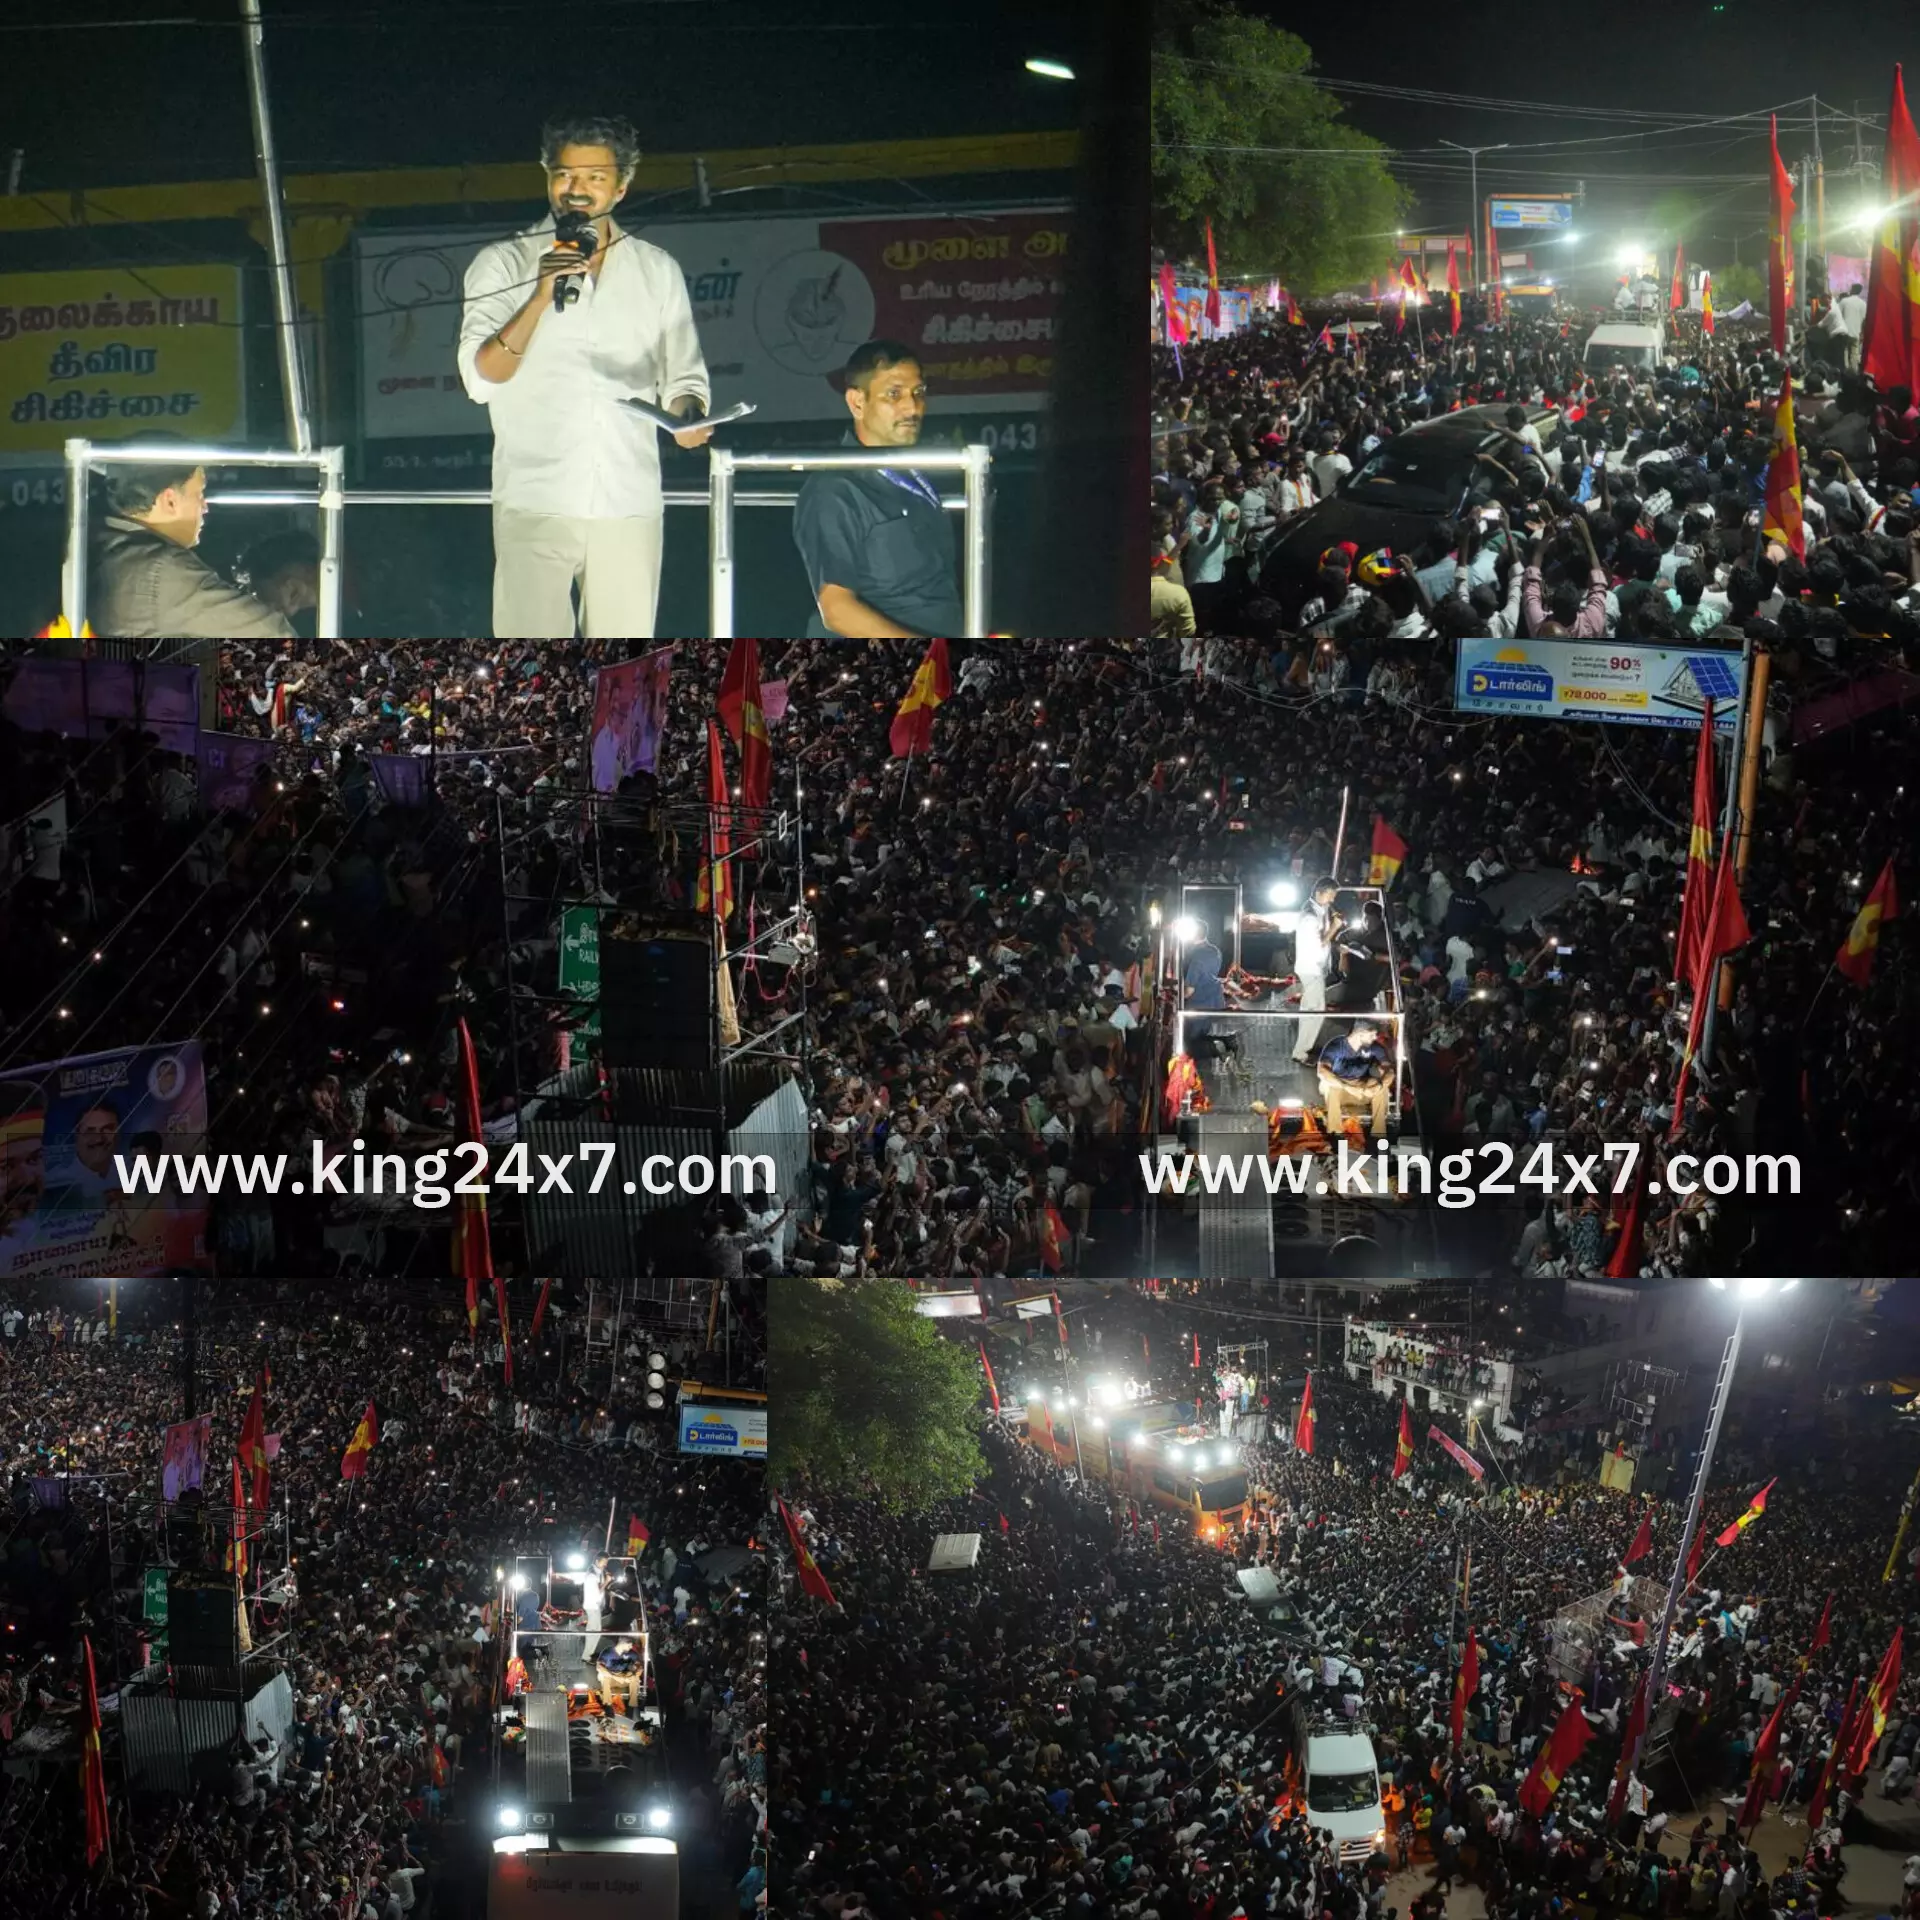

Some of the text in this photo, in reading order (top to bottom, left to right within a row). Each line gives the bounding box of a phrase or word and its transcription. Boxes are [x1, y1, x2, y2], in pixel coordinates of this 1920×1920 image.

[882, 235, 1010, 270] மூளை
[899, 280, 953, 300] உரிய
[47, 340, 157, 385] தீவிர
[10, 389, 201, 423] சிகிச்சை
[1490, 677, 1547, 693] டார்லிங்
